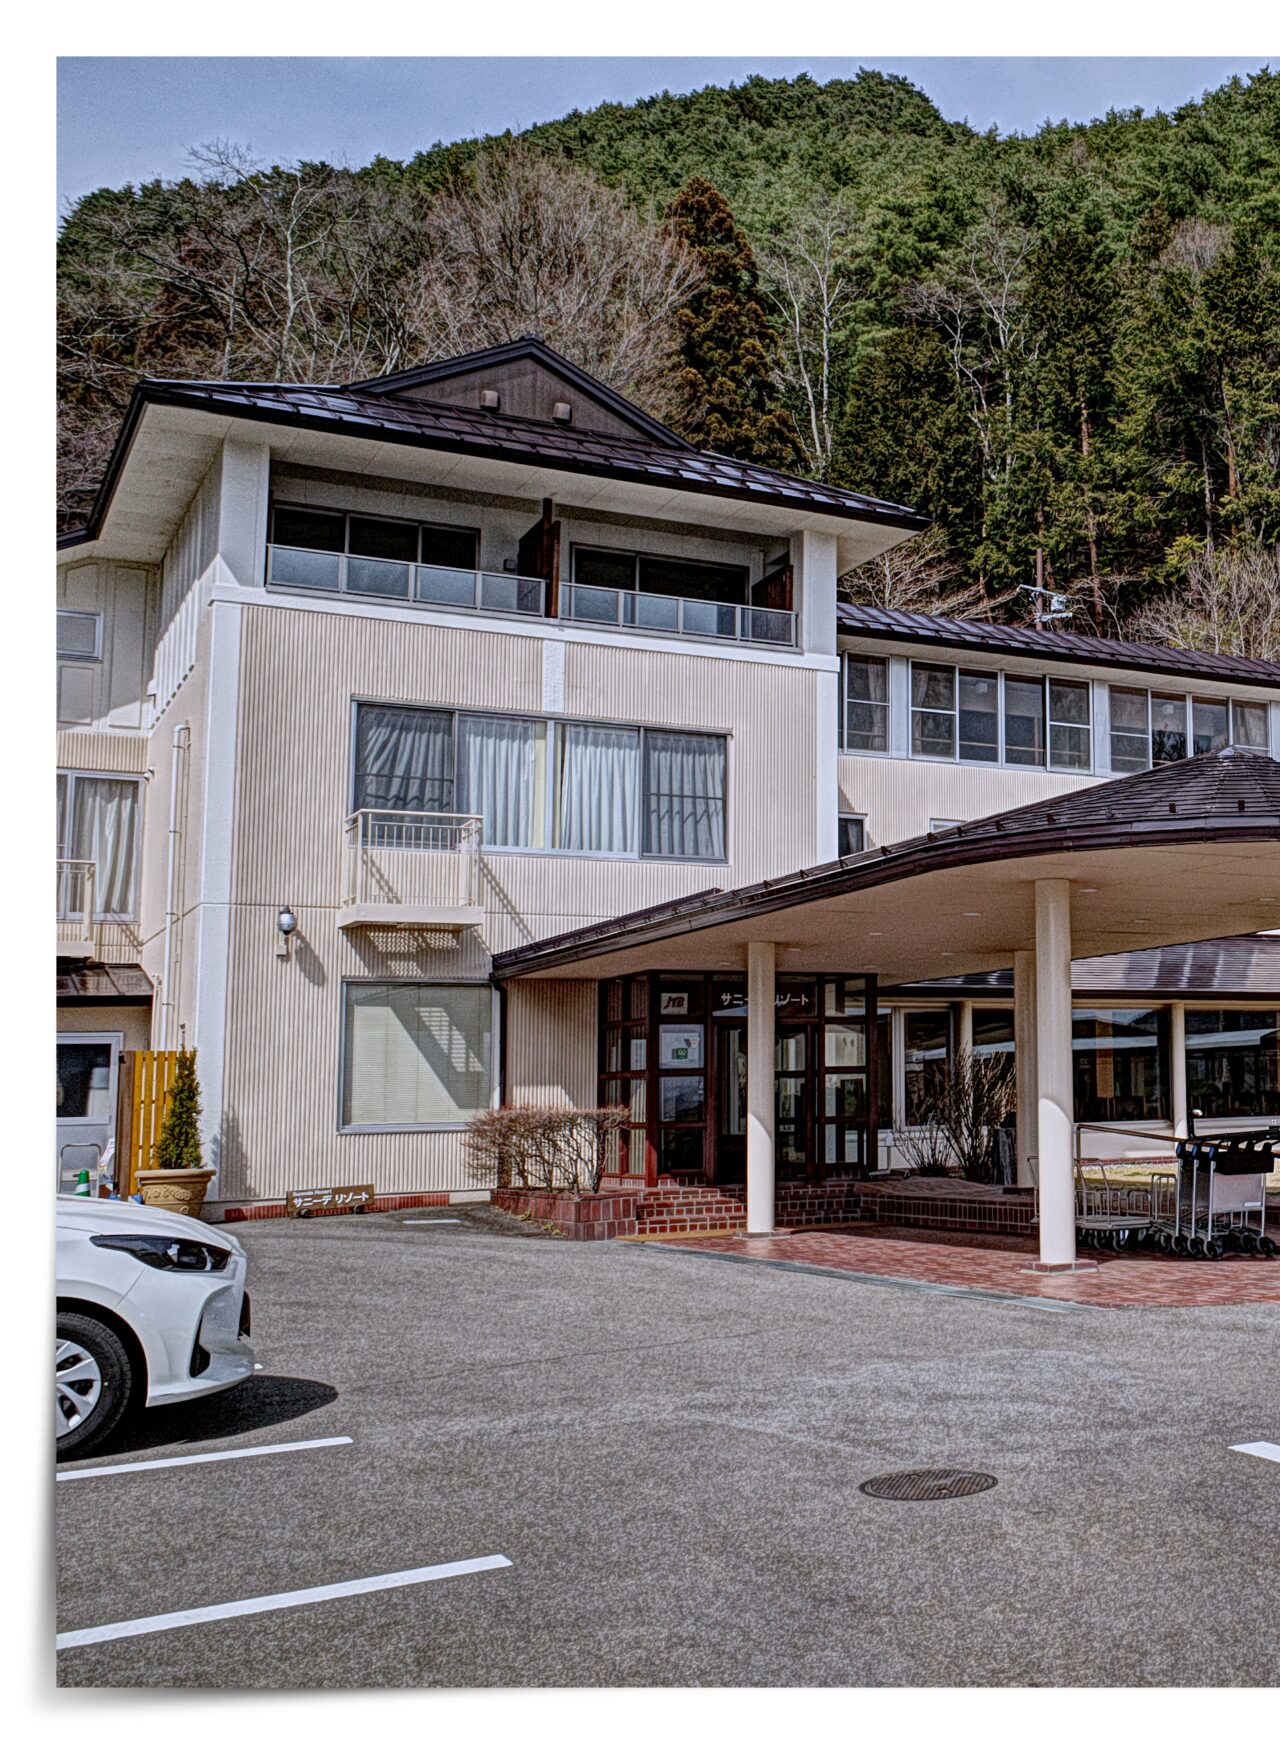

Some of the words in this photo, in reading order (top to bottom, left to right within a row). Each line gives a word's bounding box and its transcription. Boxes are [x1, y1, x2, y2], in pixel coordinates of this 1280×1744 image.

[663, 996, 685, 1009] JTB
[293, 1194, 333, 1208] サニーデ
[335, 1191, 370, 1204] リゾート
